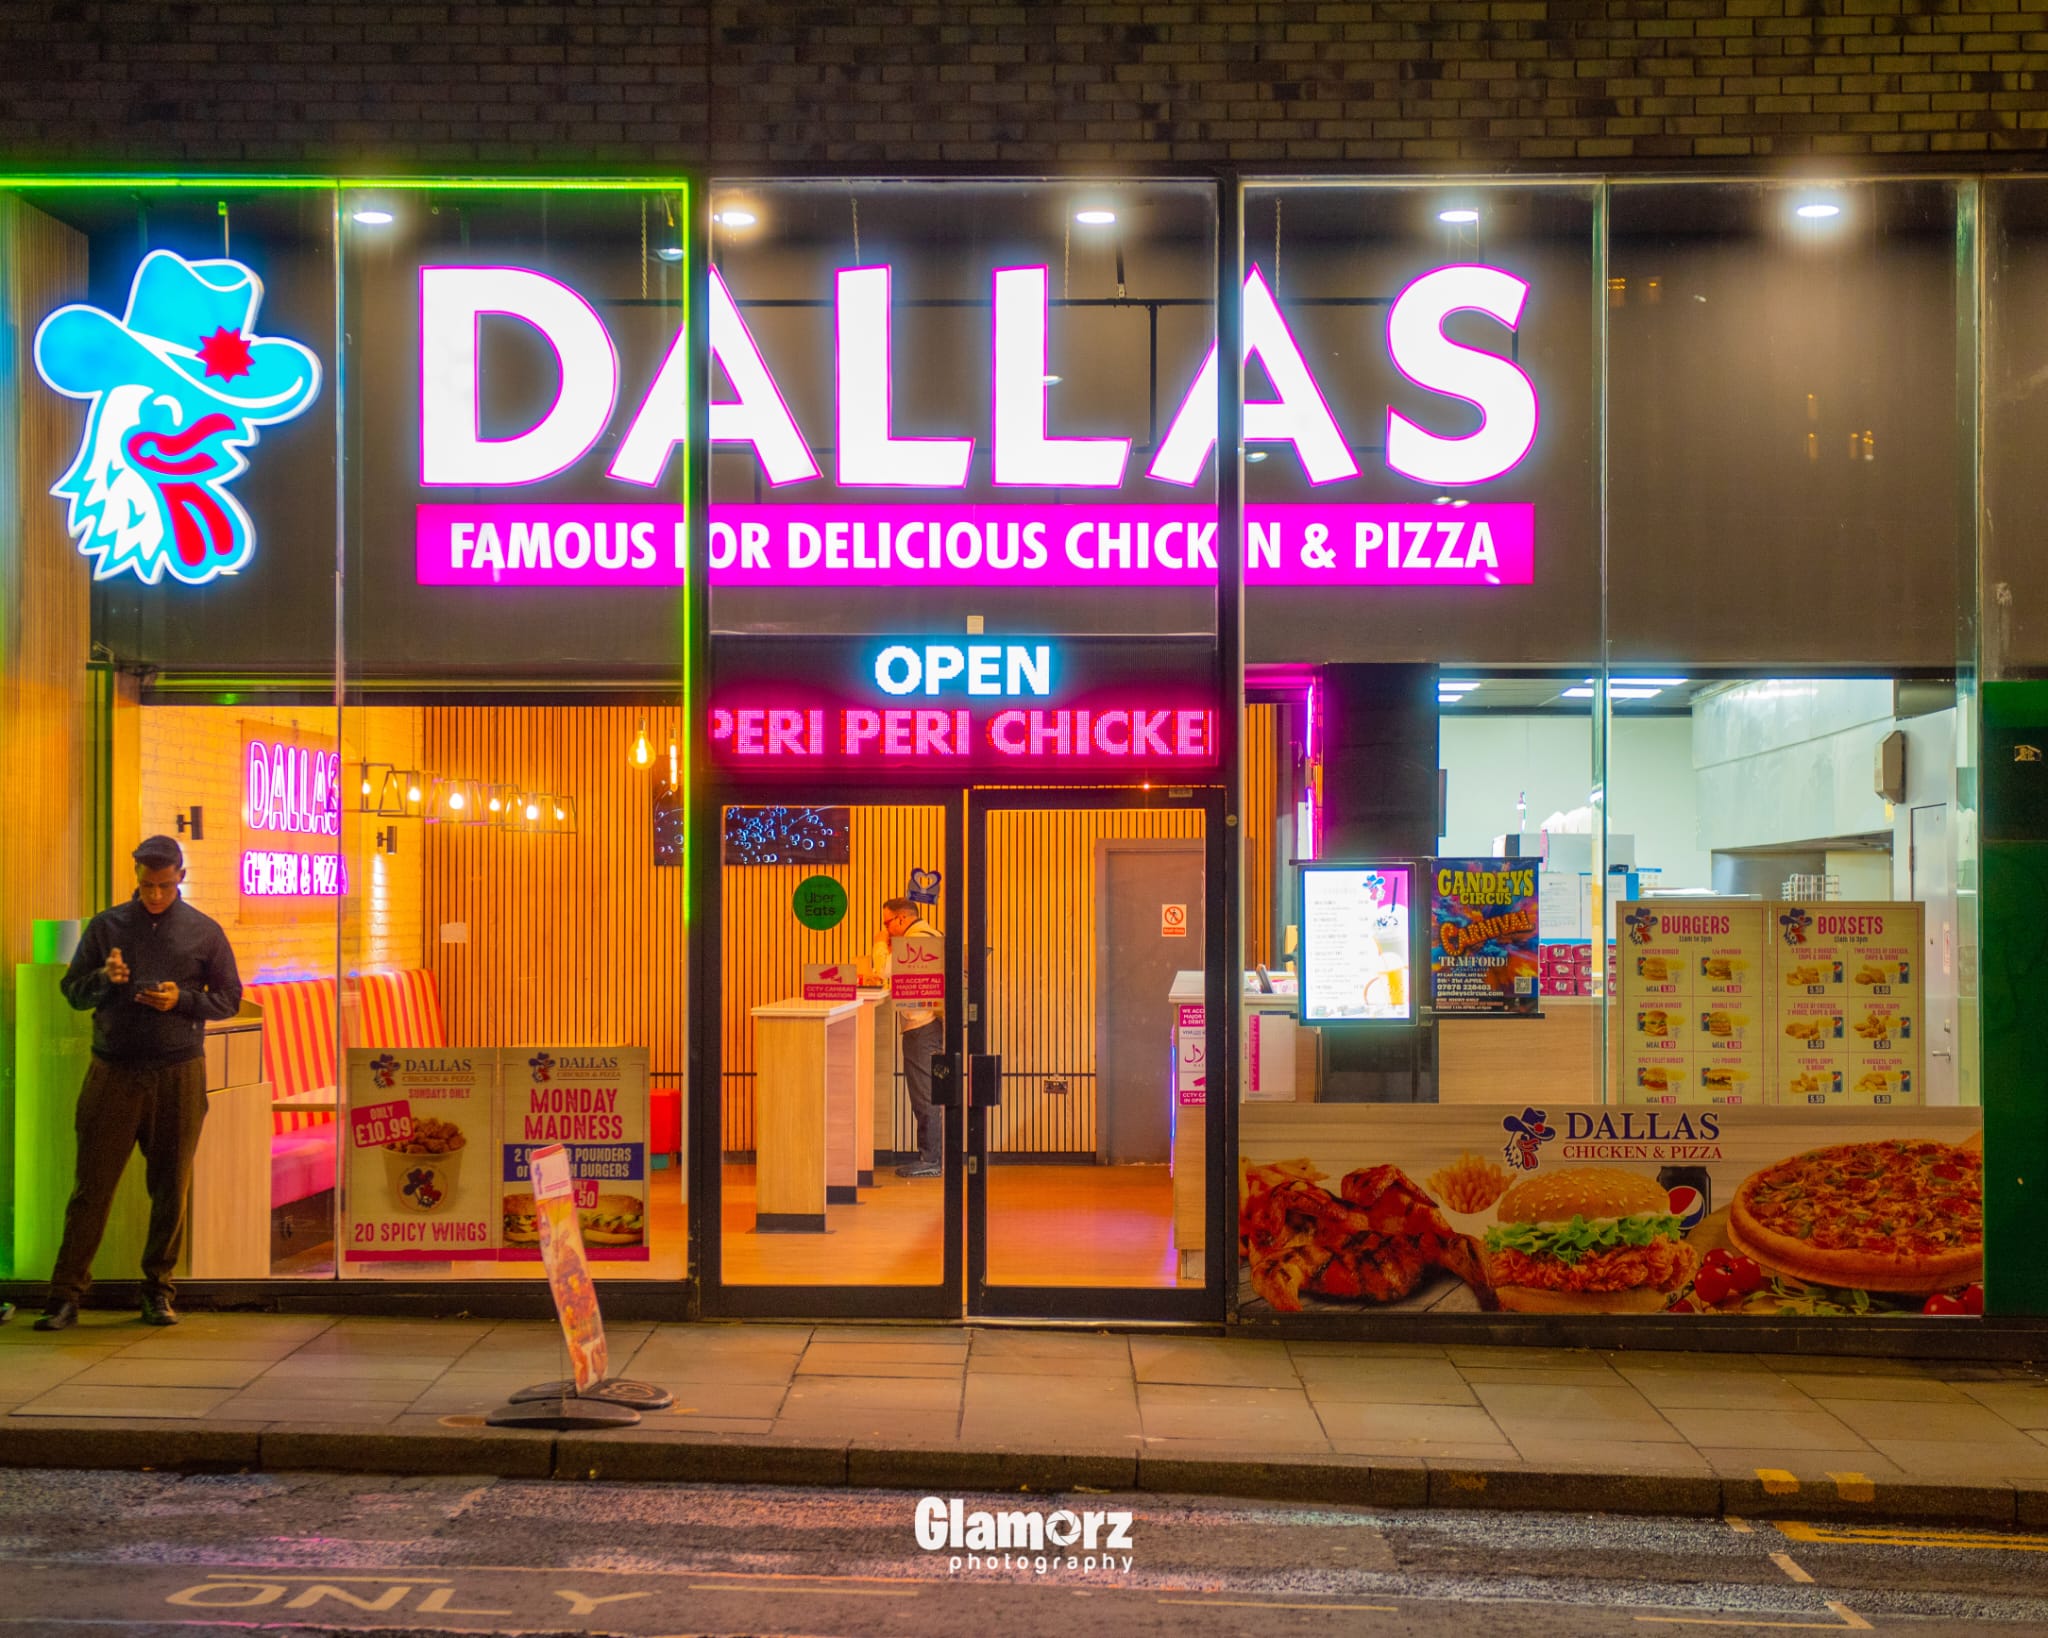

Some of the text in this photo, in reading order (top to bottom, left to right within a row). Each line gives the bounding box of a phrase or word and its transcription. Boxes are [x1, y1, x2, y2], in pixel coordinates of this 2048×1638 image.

[419, 262, 1539, 487] DALLAS
[450, 521, 657, 569] FAMOUS
[787, 521, 1047, 569] DELICIOUS
[1065, 521, 1281, 569] CHICKN
[1300, 521, 1336, 569] &
[1355, 521, 1499, 569] PIZZA
[875, 646, 1050, 695] OPEN
[844, 710, 970, 754] PERI
[989, 710, 1212, 754] CHICKE
[250, 742, 339, 835] DALLAS
[1437, 868, 1535, 897] GANDEYS
[804, 891, 835, 902] Uber
[1460, 893, 1512, 905] CIRCUS
[805, 906, 836, 917] Eats
[1440, 909, 1537, 956] CARNIVAL
[1661, 915, 1730, 934] BURGERS
[1818, 916, 1883, 935] BOXSETS
[405, 1059, 472, 1072] DALLAS
[559, 1057, 618, 1068] DALLAS
[449, 1088, 471, 1098] ONLY
[530, 1088, 617, 1113] MONDAY
[370, 1105, 394, 1120] ONLY
[355, 1116, 412, 1146] £10.99
[524, 1115, 623, 1140] MADNESS
[1565, 1111, 1720, 1141] DALLAS
[514, 1148, 522, 1161] 2
[576, 1148, 632, 1162] POUNDERS
[1562, 1145, 1722, 1159] CHICKEN & PIZZA
[581, 1163, 630, 1177] BURGERS
[354, 1222, 486, 1242] 20 SPICY WINGS
[165, 1582, 657, 1616] ONLY
